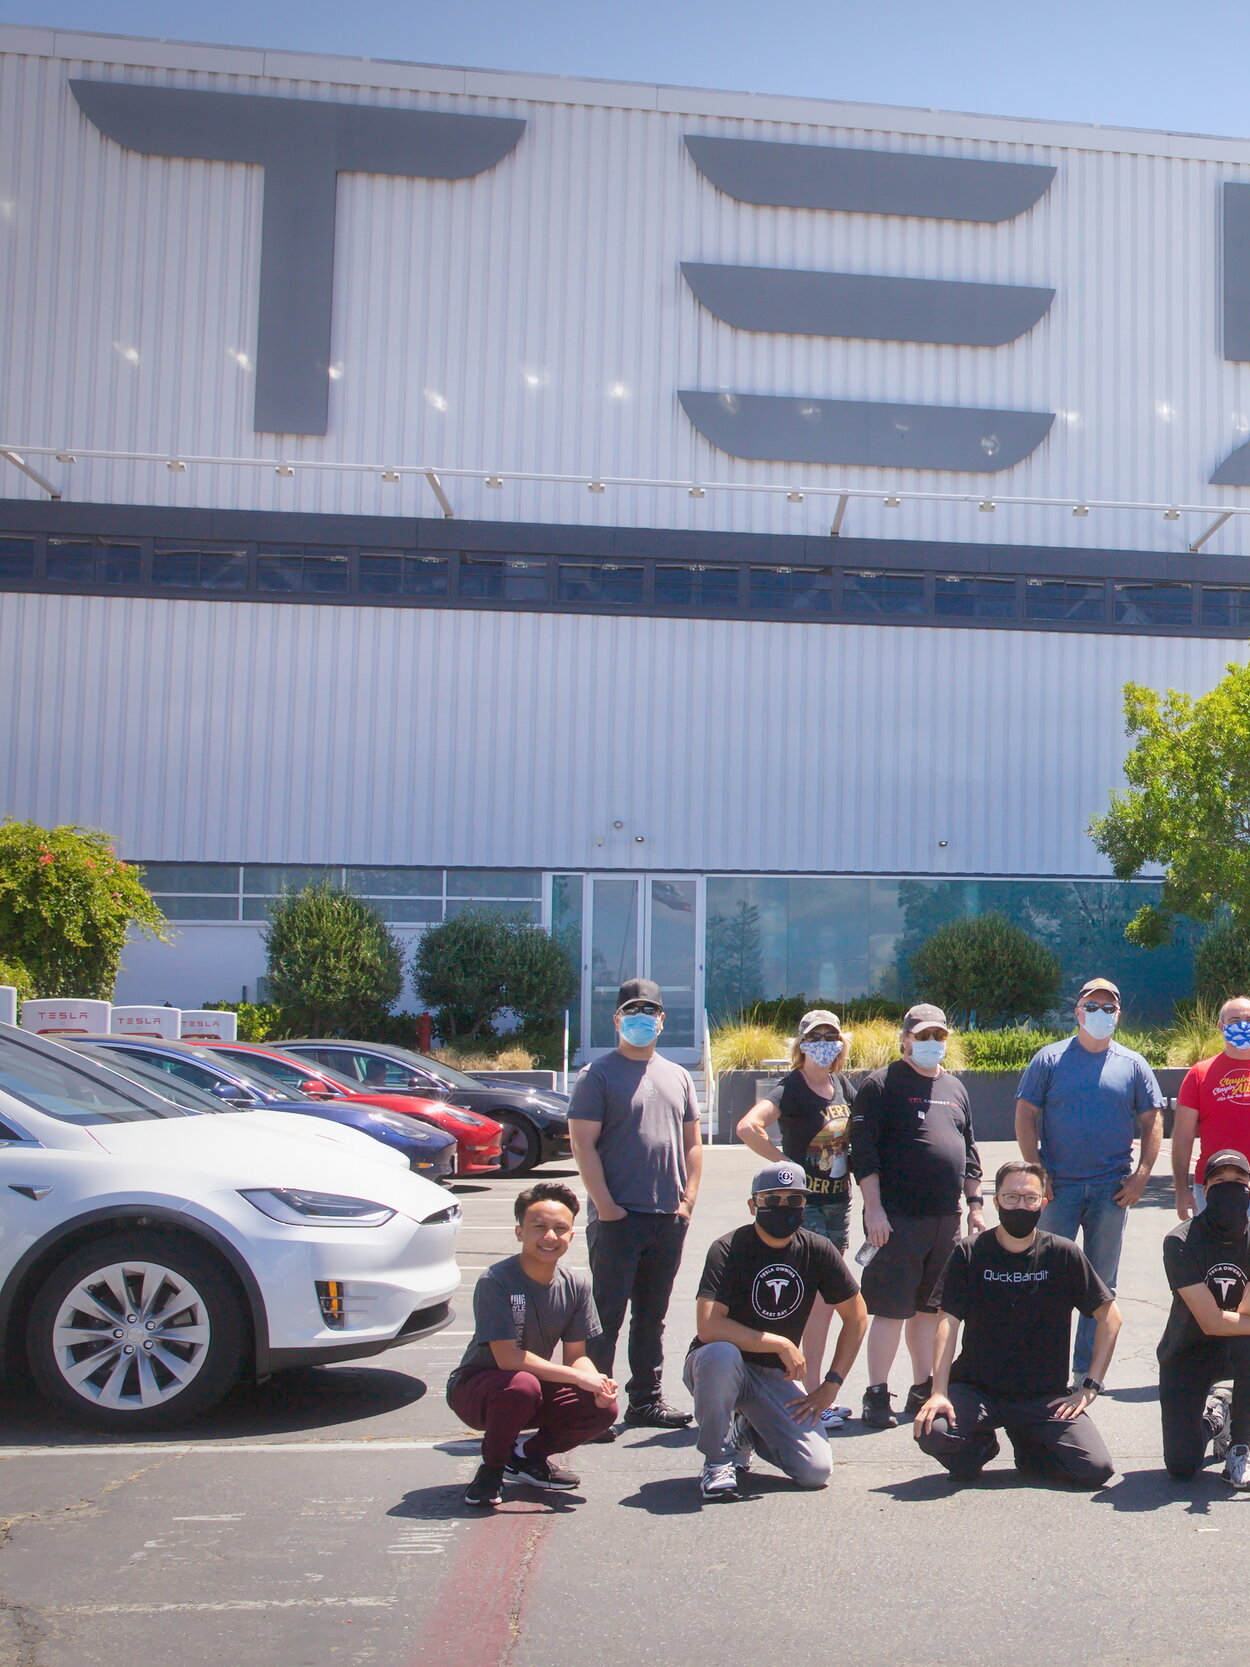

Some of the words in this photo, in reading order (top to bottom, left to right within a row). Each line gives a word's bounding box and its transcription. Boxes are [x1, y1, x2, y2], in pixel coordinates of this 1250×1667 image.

[38, 1012, 88, 1020] TESLA
[776, 1266, 796, 1278] OWNERS
[984, 1269, 1048, 1282] QuckBandit
